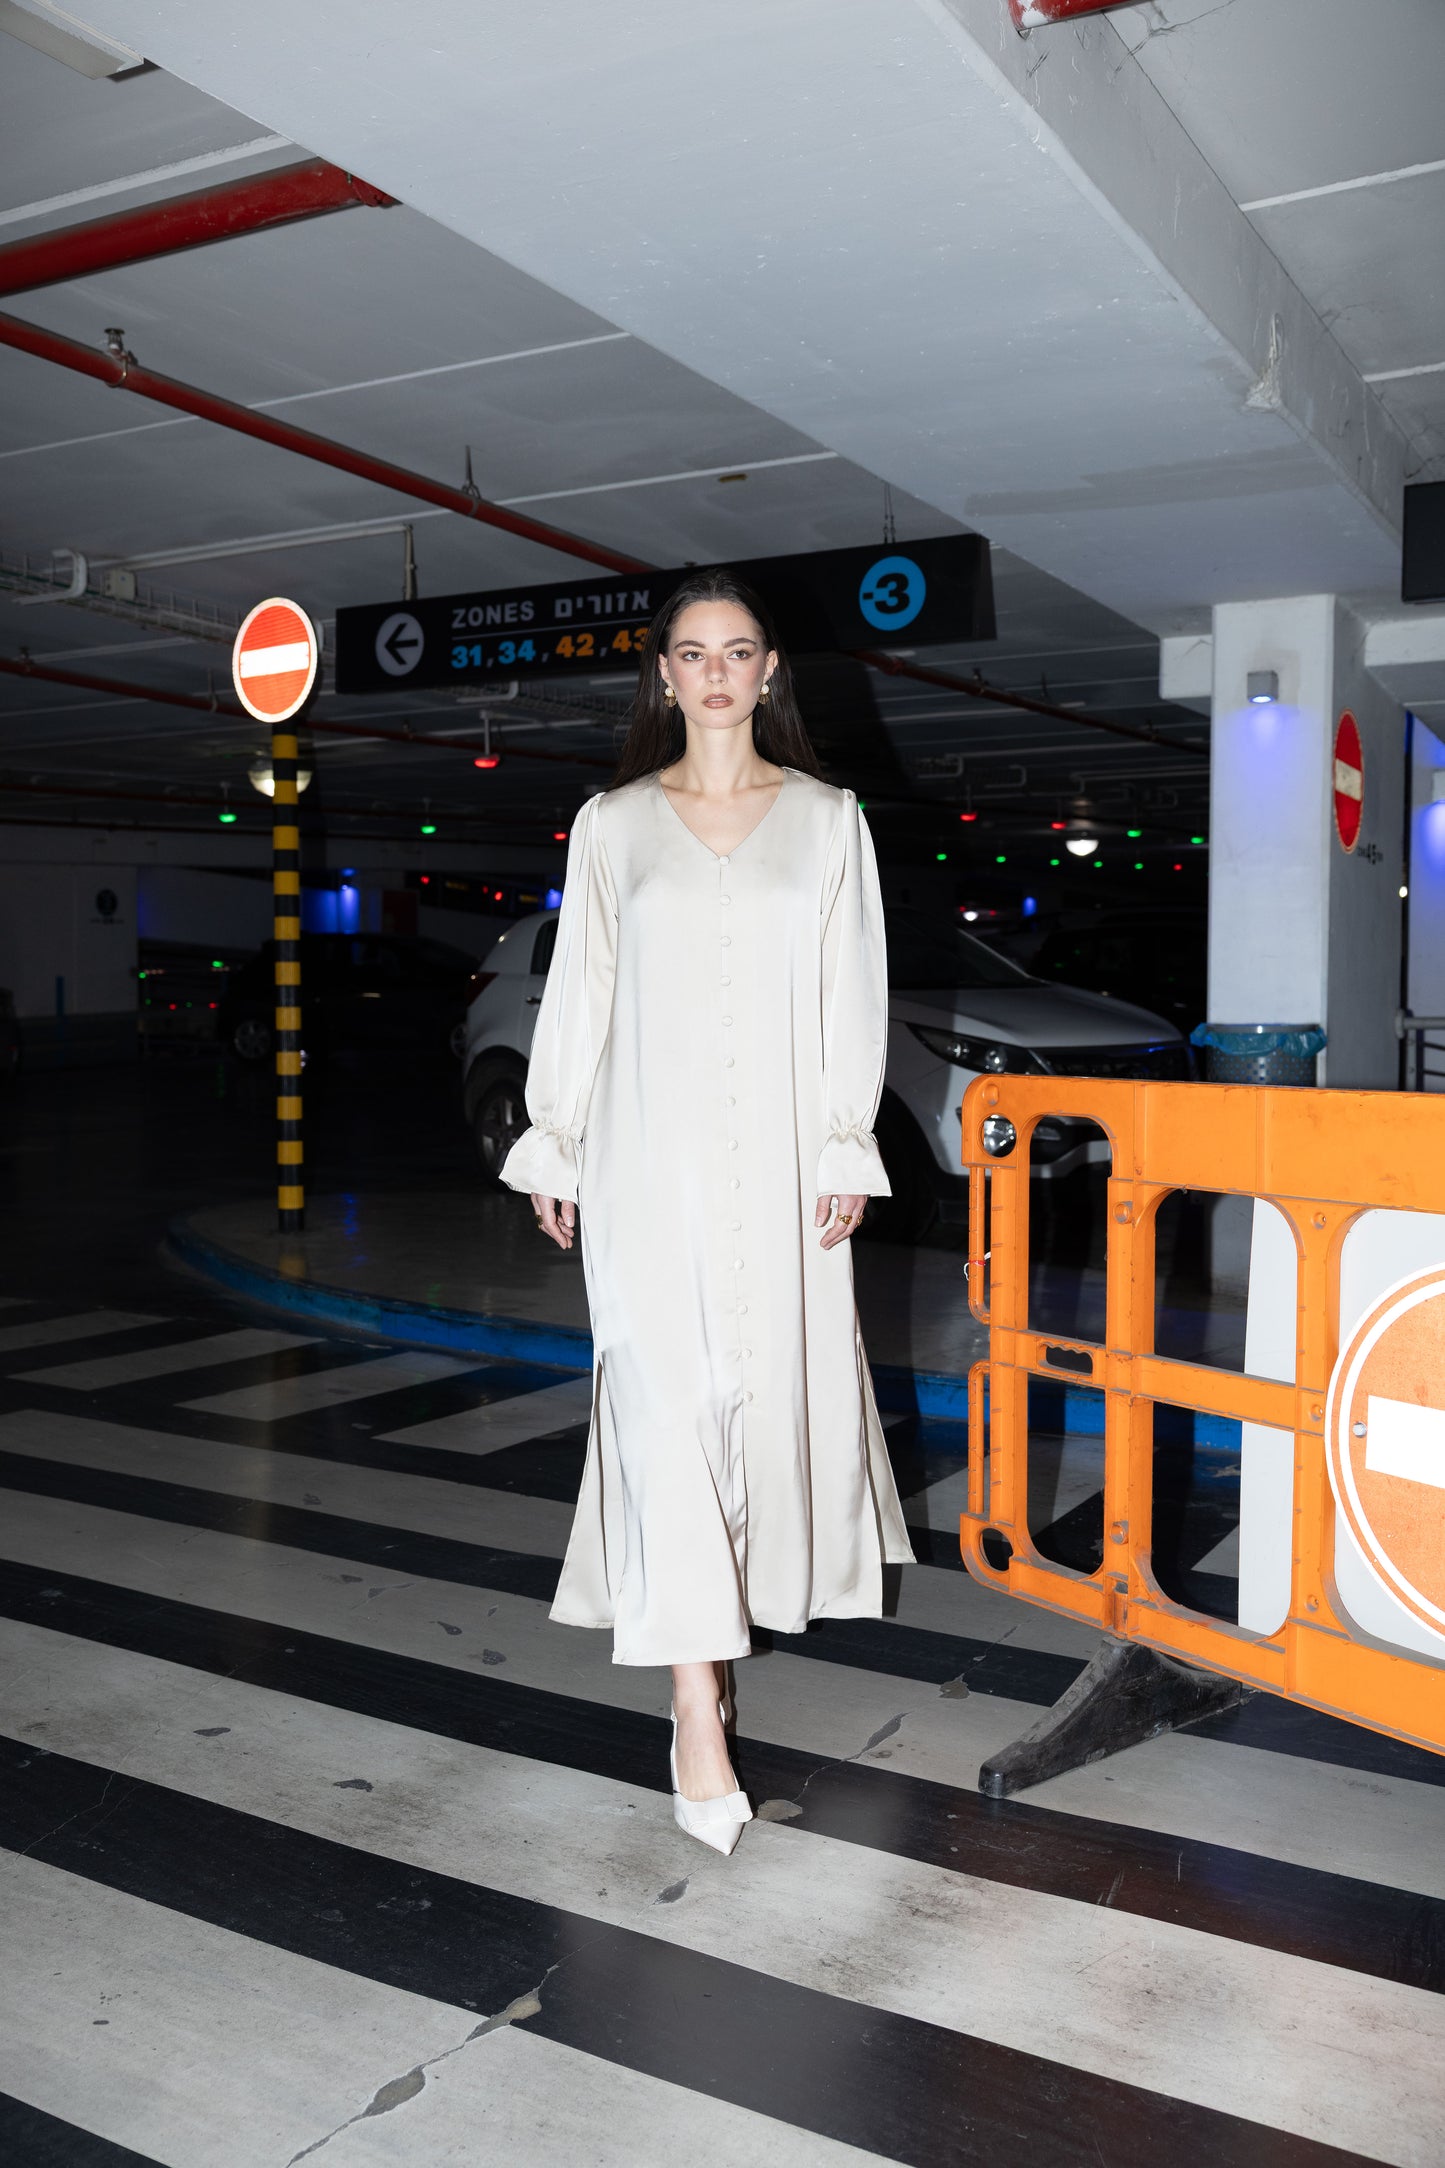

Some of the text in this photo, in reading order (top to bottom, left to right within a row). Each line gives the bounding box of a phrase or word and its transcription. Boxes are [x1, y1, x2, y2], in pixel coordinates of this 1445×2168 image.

[554, 589, 650, 619] אזורים
[863, 573, 910, 614] -3
[451, 601, 535, 628] ZONES
